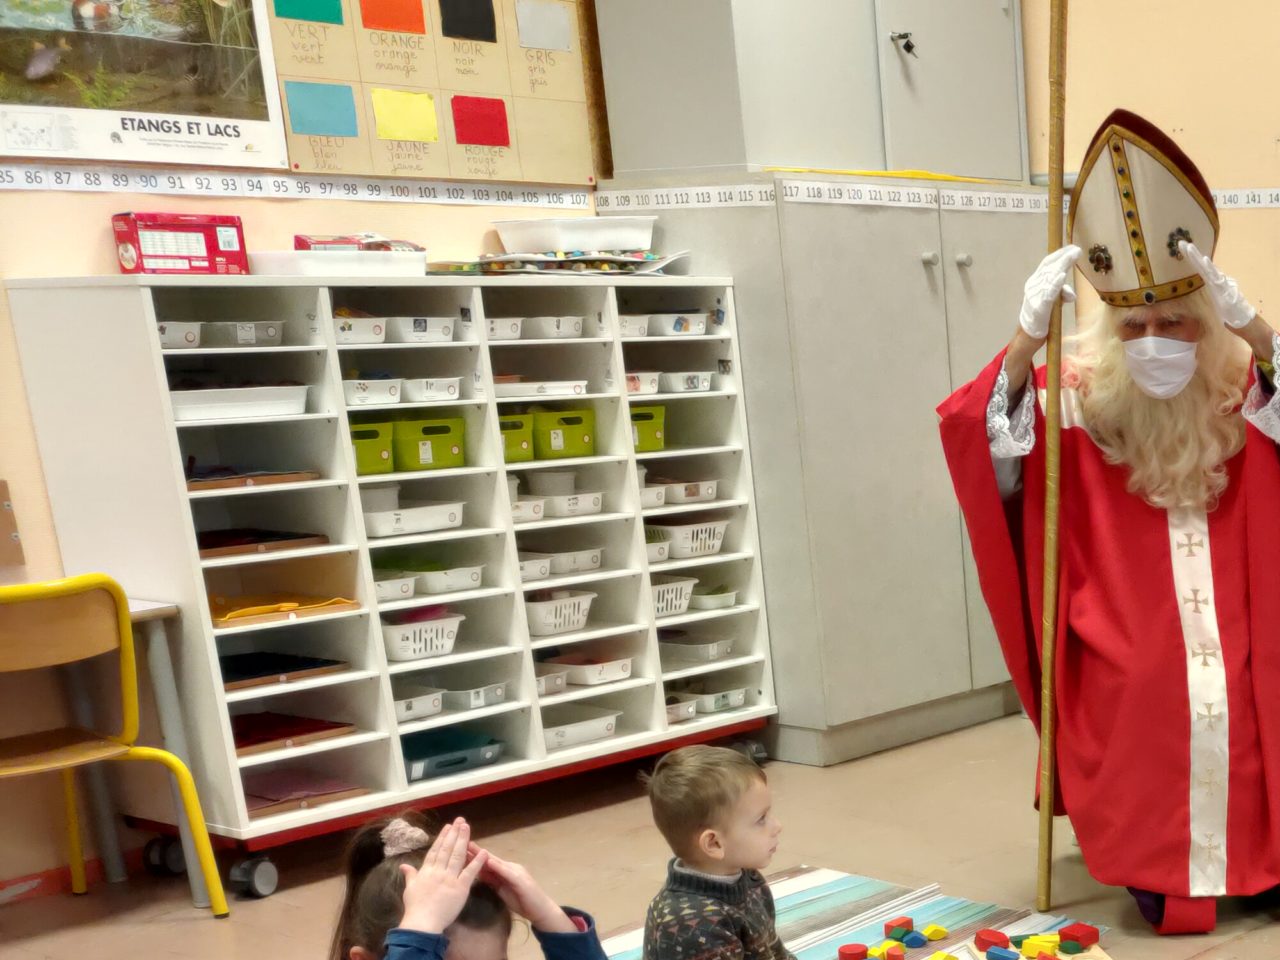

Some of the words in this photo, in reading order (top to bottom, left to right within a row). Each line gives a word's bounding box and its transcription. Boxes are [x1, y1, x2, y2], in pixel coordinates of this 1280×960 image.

[285, 22, 329, 41] VERT
[292, 42, 323, 51] vert
[370, 32, 424, 50] ORANGE
[453, 42, 484, 56] NOIR
[374, 50, 417, 64] orange
[526, 50, 555, 66] GRIS
[121, 118, 181, 134] ETANGS
[188, 122, 201, 135] ET
[207, 123, 240, 138] LACS
[387, 142, 430, 153] JAUNE
[465, 146, 504, 158] ROUGE
[25, 171, 43, 184] 86
[55, 172, 71, 184] 87
[84, 173, 101, 185] 88
[112, 174, 129, 186] 89
[140, 175, 158, 188] 90
[168, 176, 185, 189] 91
[196, 178, 212, 190] 92
[222, 178, 238, 191] 93
[247, 180, 262, 191] 94
[274, 180, 288, 192] 95
[296, 182, 310, 194] 96
[320, 183, 333, 194] 97
[344, 184, 358, 195] 98
[367, 185, 381, 196] 99
[390, 186, 409, 197] 100
[419, 187, 437, 198] 101
[446, 188, 464, 199] 102
[472, 189, 489, 200] 103
[496, 191, 513, 201] 104
[522, 192, 539, 203] 105
[546, 193, 563, 204] 106
[570, 194, 586, 205] 107
[596, 196, 609, 207] 108
[616, 196, 630, 206] 109
[637, 194, 649, 205] 110
[656, 194, 670, 205] 111
[675, 193, 689, 204] 112
[696, 192, 711, 203] 113
[718, 191, 733, 202] 114
[739, 191, 753, 202] 115
[759, 190, 774, 201] 116
[784, 186, 799, 197] 117
[806, 187, 822, 198] 118
[828, 188, 842, 199] 119
[847, 189, 862, 200] 120
[868, 190, 883, 201] 121
[888, 191, 901, 202] 122
[907, 192, 921, 203] 123
[925, 193, 938, 204] 124
[942, 194, 955, 205] 125
[960, 196, 973, 206] 126
[978, 197, 990, 207] 127
[994, 197, 1006, 208] 128
[1012, 198, 1024, 208] 129
[1029, 199, 1041, 209] 130
[1222, 194, 1239, 205] 140
[1246, 193, 1261, 204] 141
